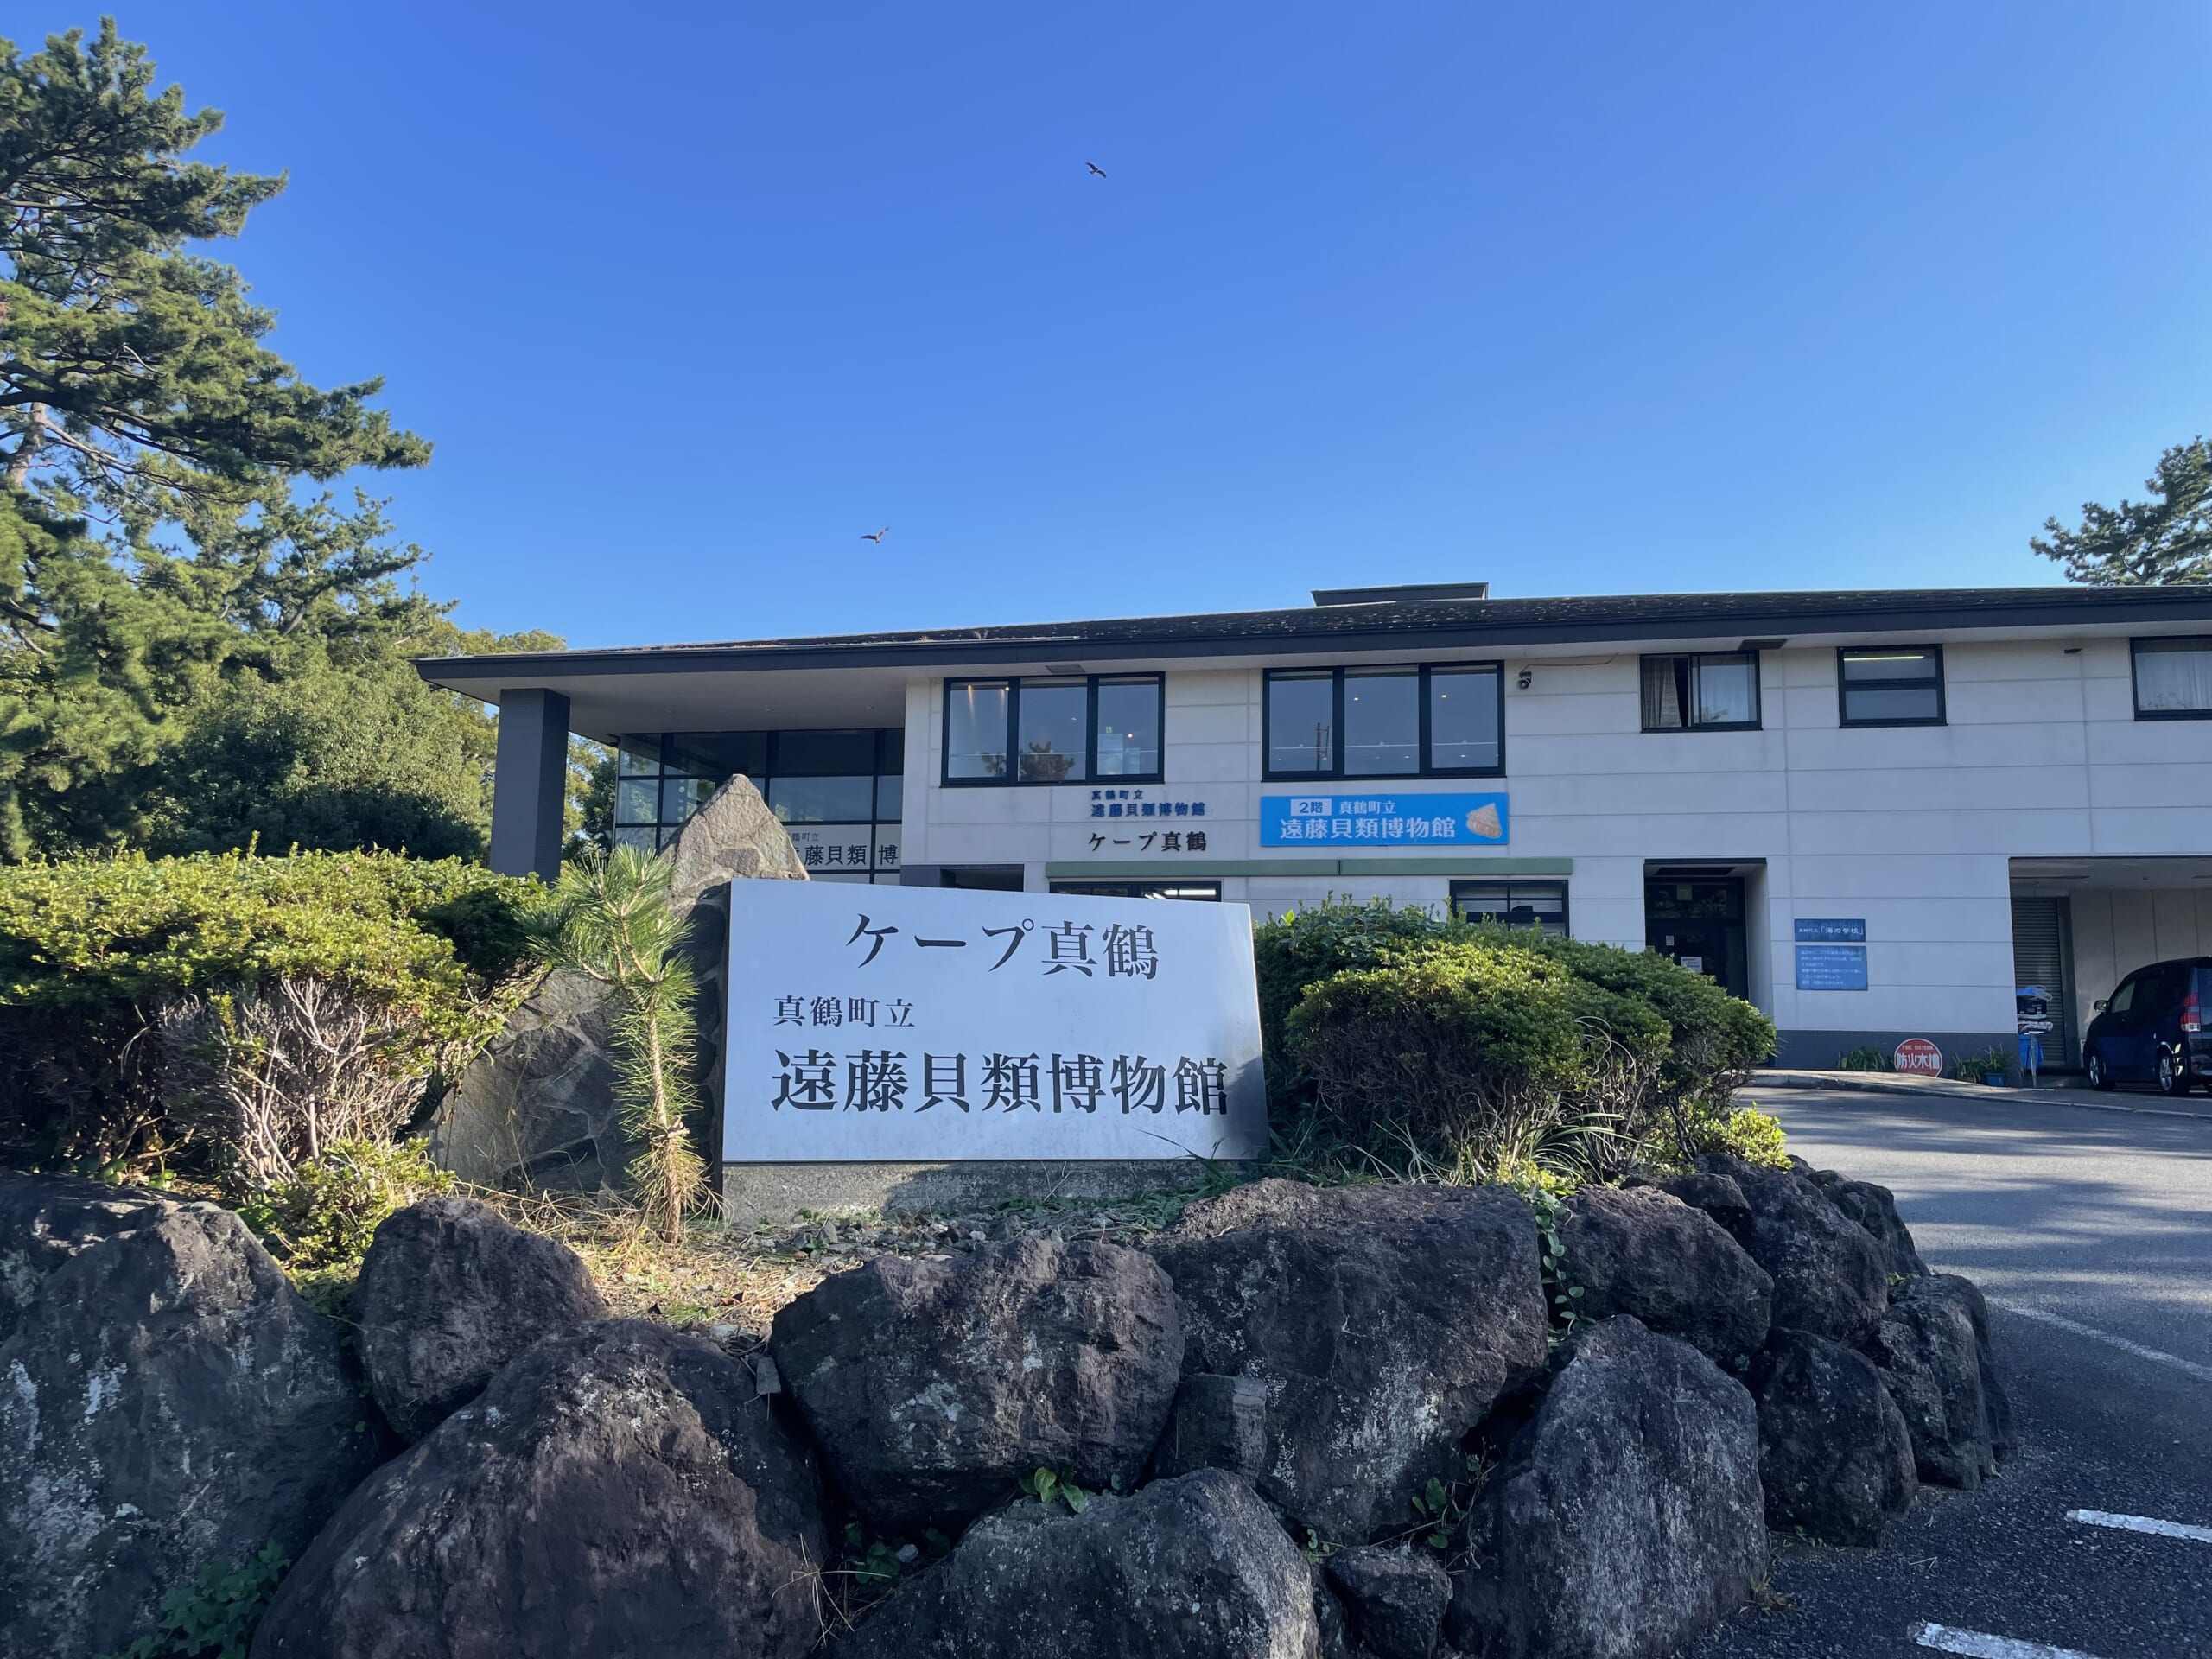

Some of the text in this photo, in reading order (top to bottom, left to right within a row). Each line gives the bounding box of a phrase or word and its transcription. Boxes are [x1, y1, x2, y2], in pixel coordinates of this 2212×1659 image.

[1091, 789, 1143, 800] 真鶴町立
[1090, 802, 1205, 817] 遠藤貝類博物館
[1299, 800, 1396, 815] 2階 真鶴町立
[787, 832, 820, 842] 鶴町立
[1280, 817, 1456, 839] 遠藤貝類博物館
[1089, 830, 1207, 851] ケープ真鶴
[794, 844, 899, 866] 藤貝類博
[845, 912, 1159, 980] ケープ真鶴
[772, 995, 916, 1028] 真鶴町立
[770, 1048, 1230, 1116] 遠藤貝類博物館
